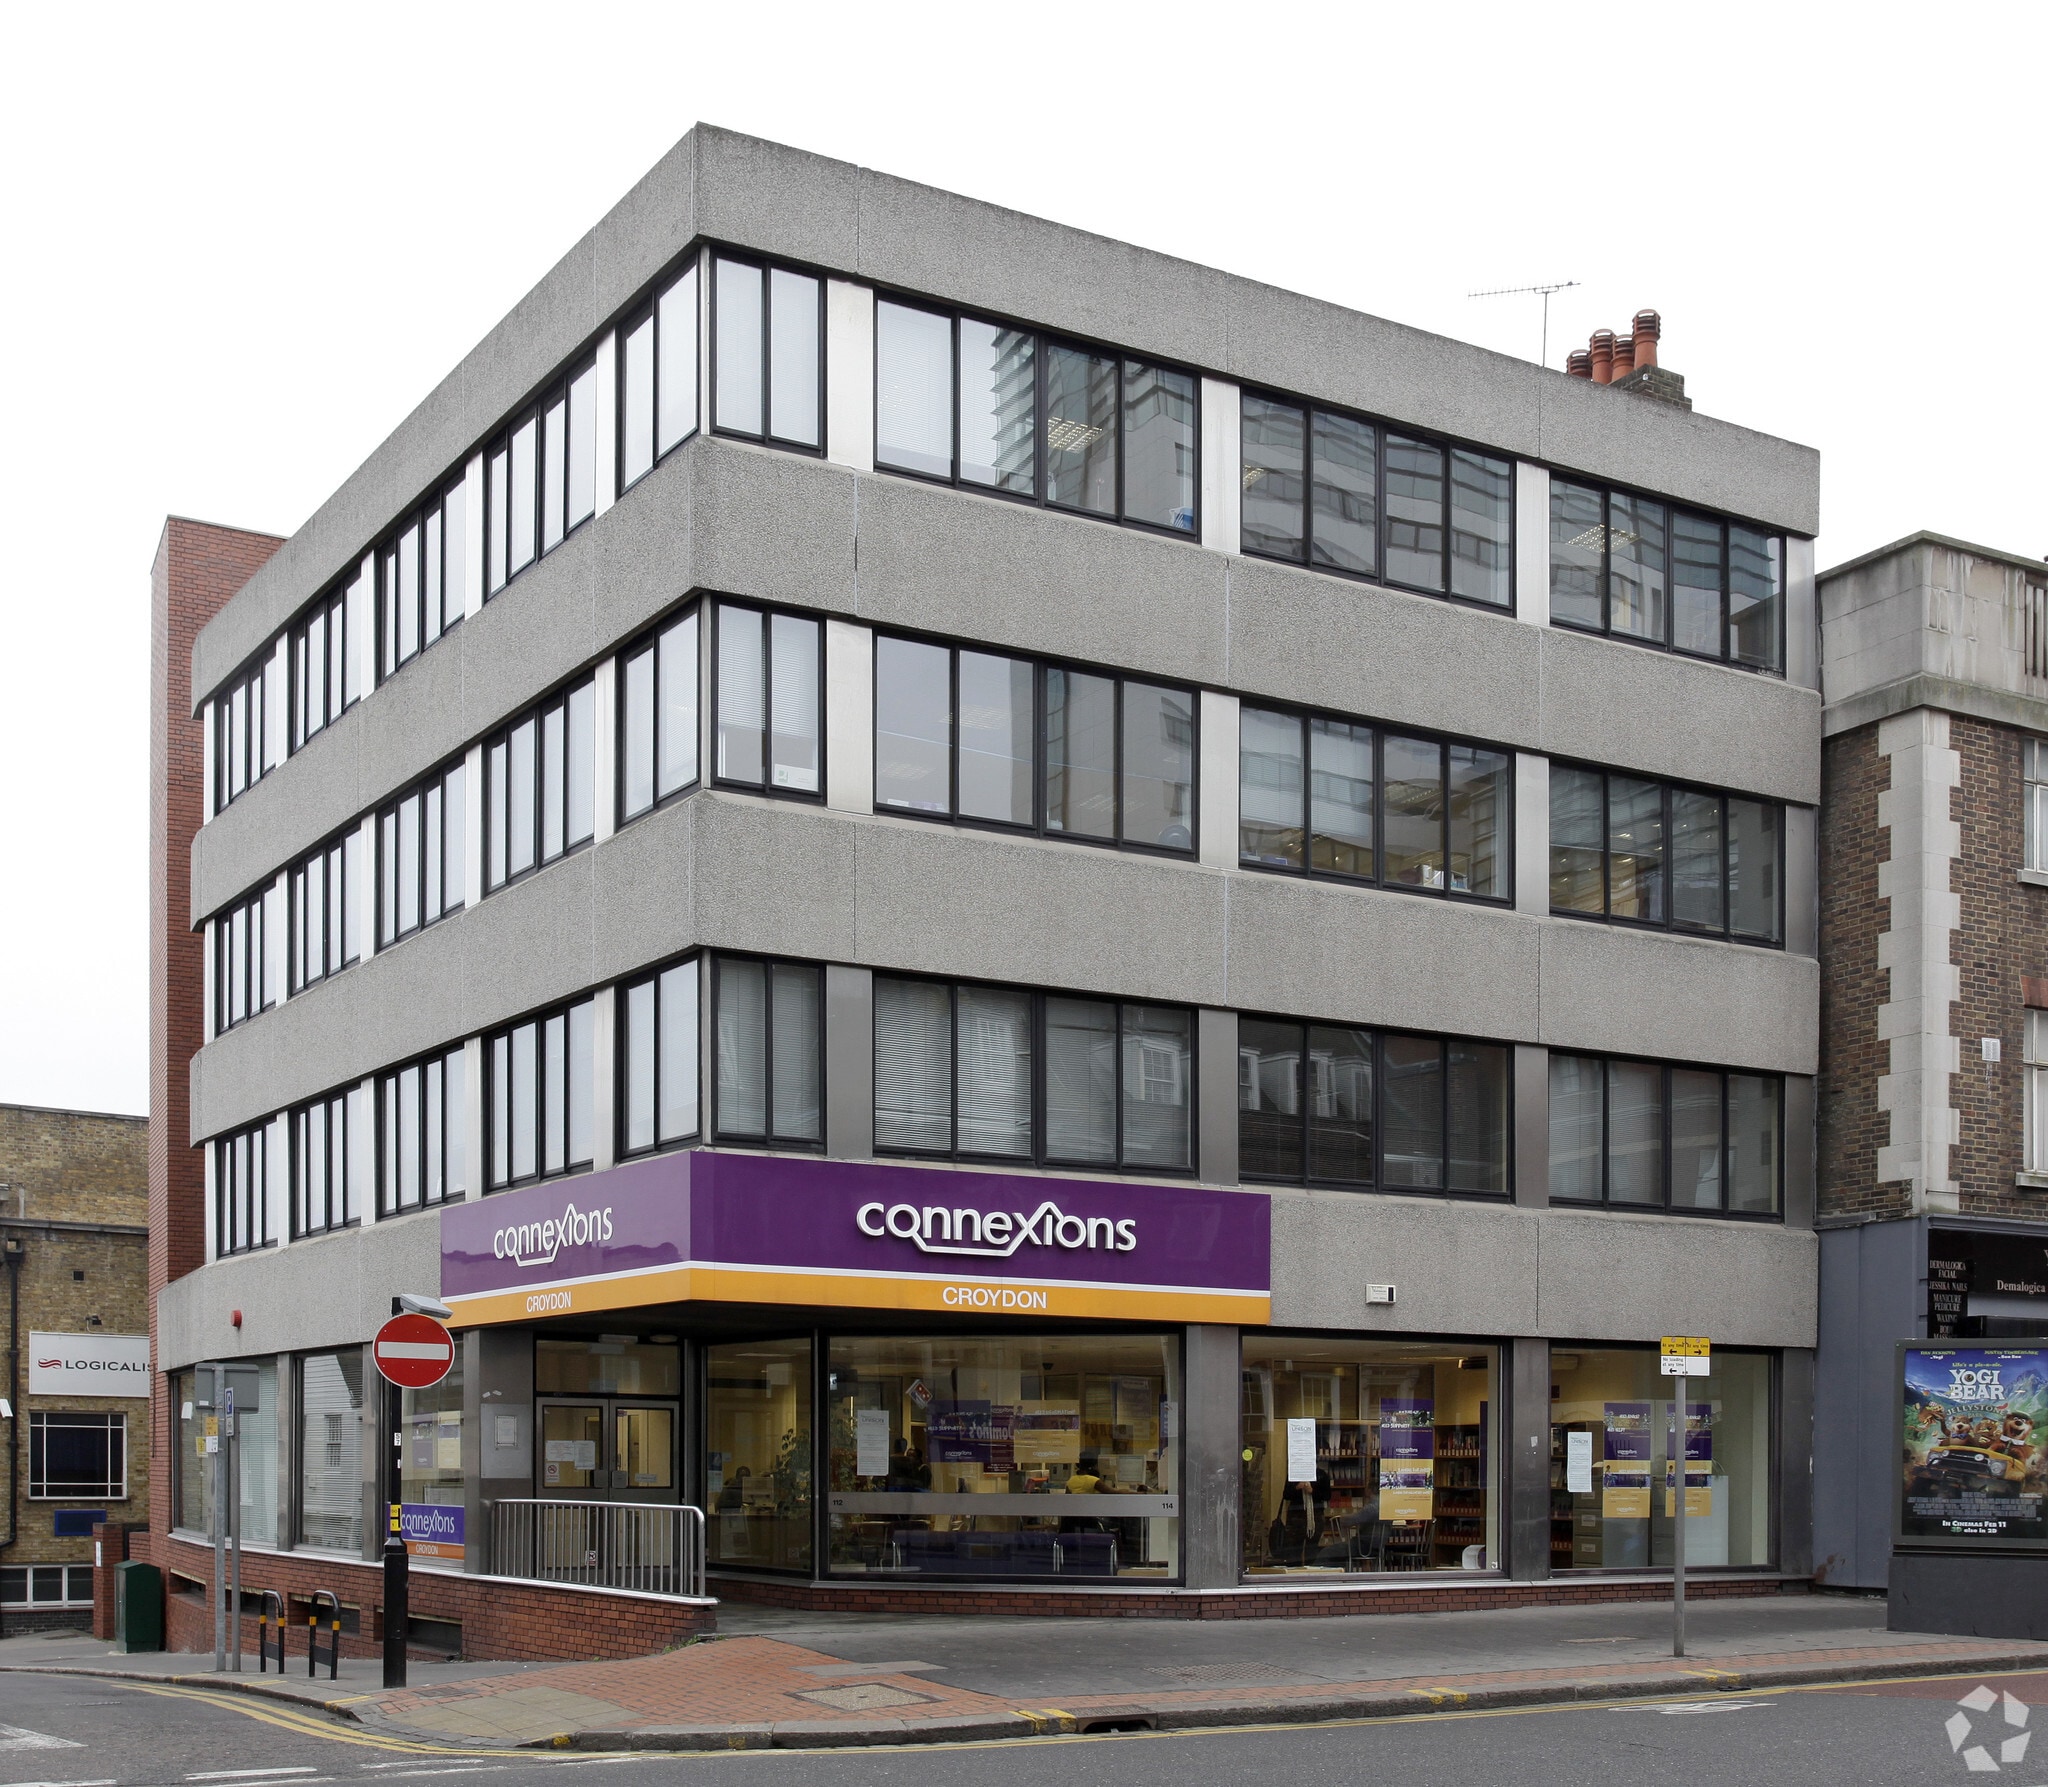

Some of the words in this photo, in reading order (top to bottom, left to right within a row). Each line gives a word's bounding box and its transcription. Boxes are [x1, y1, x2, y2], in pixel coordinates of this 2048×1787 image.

[1938, 1269, 1957, 1279] FACIAL
[1952, 1282, 1968, 1292] NAILS
[1997, 1279, 2046, 1295] Demalogica
[526, 1291, 572, 1313] CROYDON
[942, 1286, 1047, 1309] CROYDON
[1948, 1368, 2001, 1385] YOGI
[1948, 1383, 2005, 1400] BEAR
[416, 1544, 439, 1555] CROYDON
